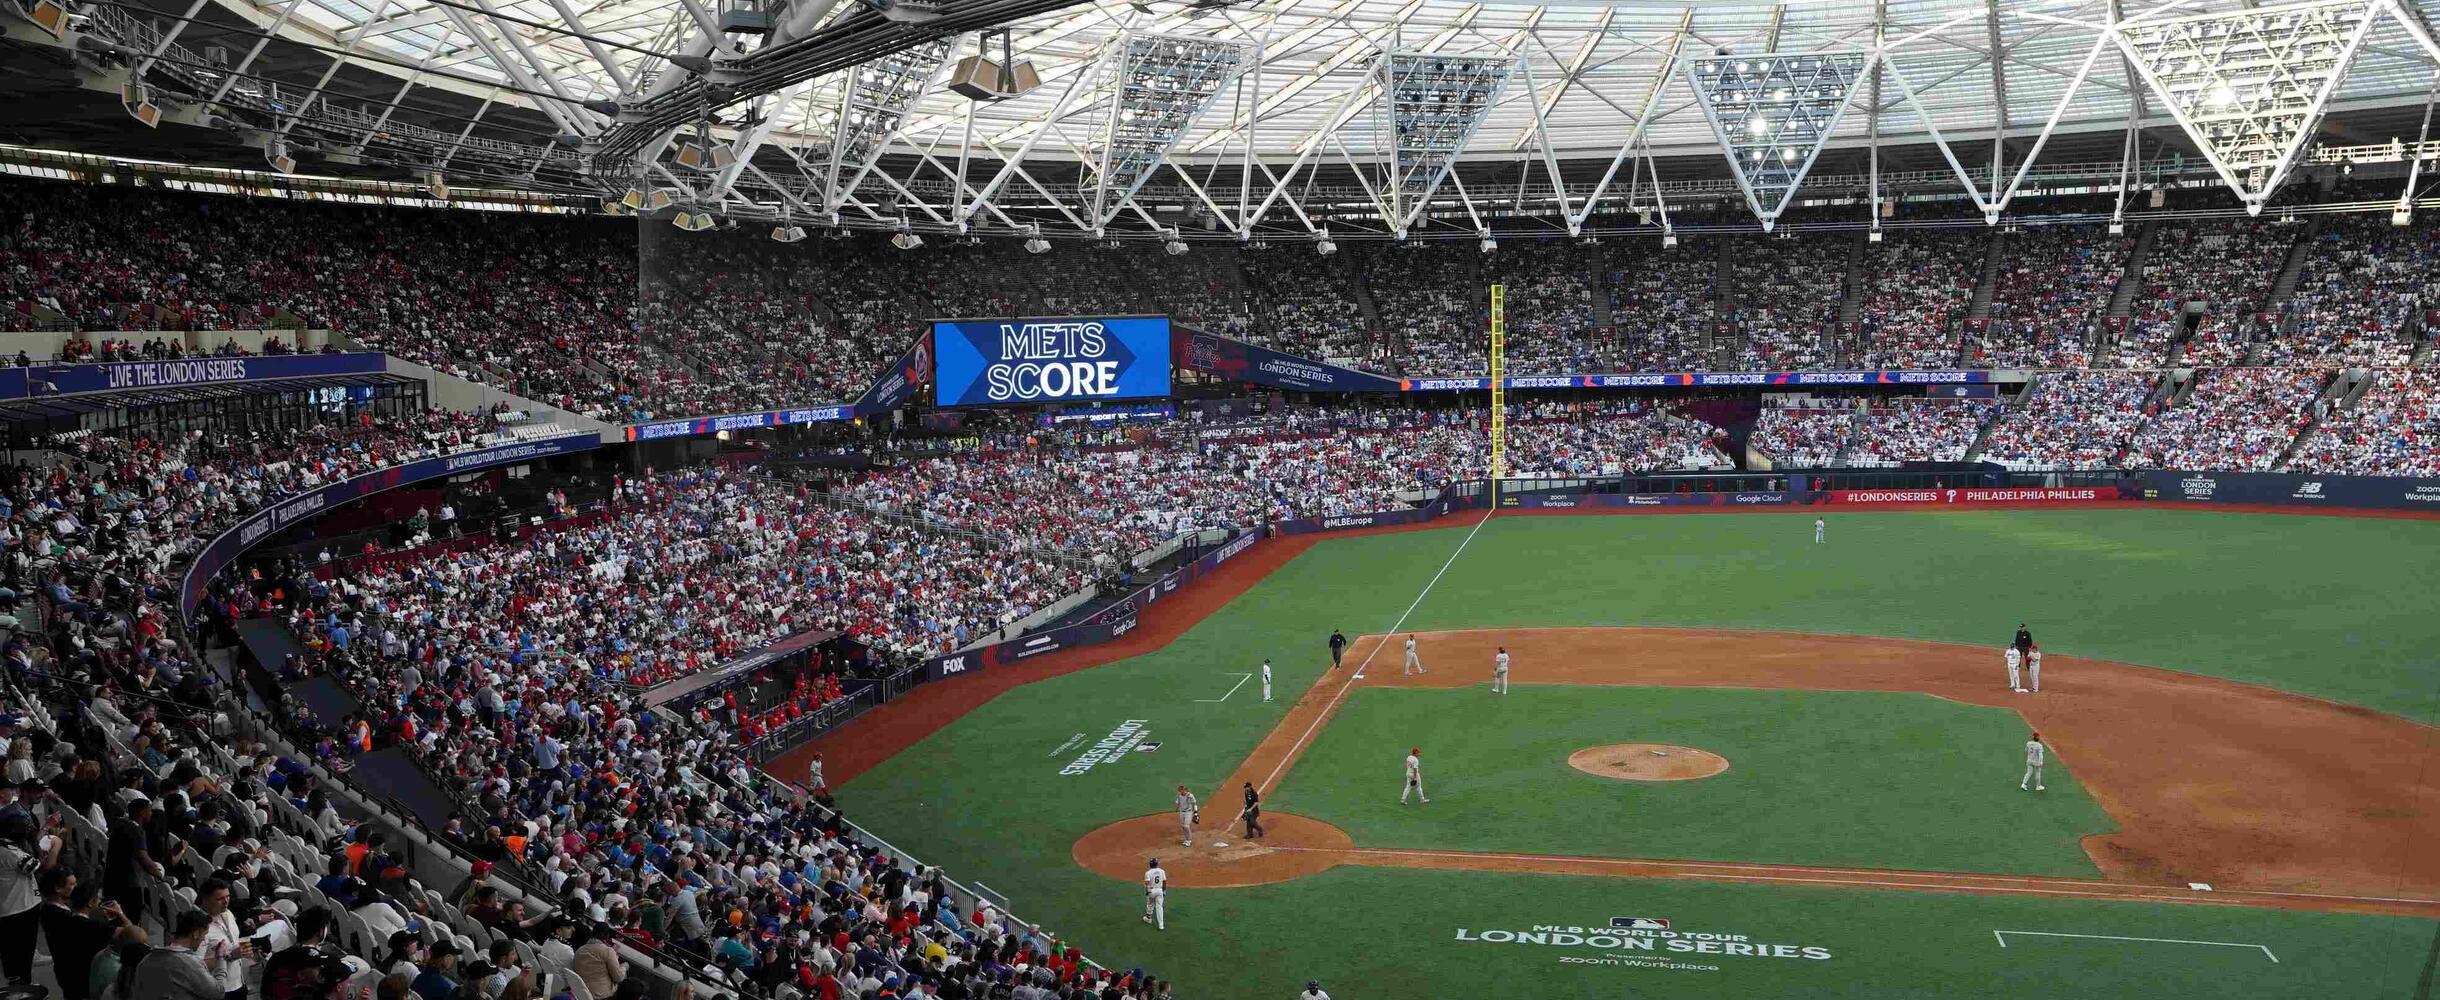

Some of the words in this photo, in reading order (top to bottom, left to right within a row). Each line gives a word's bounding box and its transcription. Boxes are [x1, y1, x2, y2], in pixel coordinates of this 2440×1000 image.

[1000, 322, 1106, 360] METS
[109, 364, 132, 387] LIVE
[135, 363, 157, 385] THE
[158, 361, 206, 384] LONDON
[207, 360, 246, 379] SERIES
[987, 361, 1120, 400] SCORE
[1259, 362, 1300, 377] LONDON
[1301, 370, 1334, 383] SERIES
[1604, 376, 1631, 386] METS
[1631, 375, 1665, 385] SCORE
[1703, 375, 1731, 384] METS
[1732, 374, 1766, 384] SCORE
[1800, 374, 1828, 383] METS
[1829, 373, 1864, 382] SCORE
[1900, 373, 1929, 382] METS
[1930, 372, 1967, 382] SCORE
[1420, 380, 1446, 389] METS
[1447, 379, 1479, 389] SCORE
[1511, 379, 1538, 388] METS
[1539, 378, 1571, 387] SCORE
[715, 418, 737, 430] METS
[737, 414, 764, 428] SCORE
[789, 410, 813, 423] METS
[813, 407, 839, 421] SCORE
[643, 425, 665, 439] METS
[665, 422, 690, 437] SCORE
[464, 455, 482, 465] WORLD
[482, 452, 495, 463] TOUR
[495, 449, 518, 460] LONDON
[518, 445, 536, 457] SERIES
[1736, 494, 1761, 503] Google
[1762, 494, 1782, 502] Cloud
[1848, 491, 1937, 502] #LONDONSERIES
[1967, 491, 2045, 500] PHILADELPHIA
[2048, 490, 2095, 500] PHILLIES
[279, 500, 306, 523] PHILADELPHIA
[306, 493, 324, 511] PHILLIES
[1324, 516, 1373, 528] @MLBEurope
[1231, 539, 1244, 554] LONDON
[1244, 532, 1254, 547] SERIES
[1113, 622, 1127, 637] Google
[1127, 616, 1137, 631] Cloud
[943, 656, 965, 675] FOX
[1094, 719, 1149, 749] LONDON
[1058, 748, 1110, 775] SERIES
[1154, 876, 1160, 884] 6
[1533, 925, 1584, 933] MLB
[1588, 927, 1678, 938] WORLD
[1683, 932, 1748, 942] TOUR
[1454, 928, 1656, 950] LONDON
[1666, 939, 1832, 960] SERIES
[1559, 956, 1618, 965] zoom
[1624, 959, 1720, 971] Workplace
[1606, 952, 1656, 960] Presented
